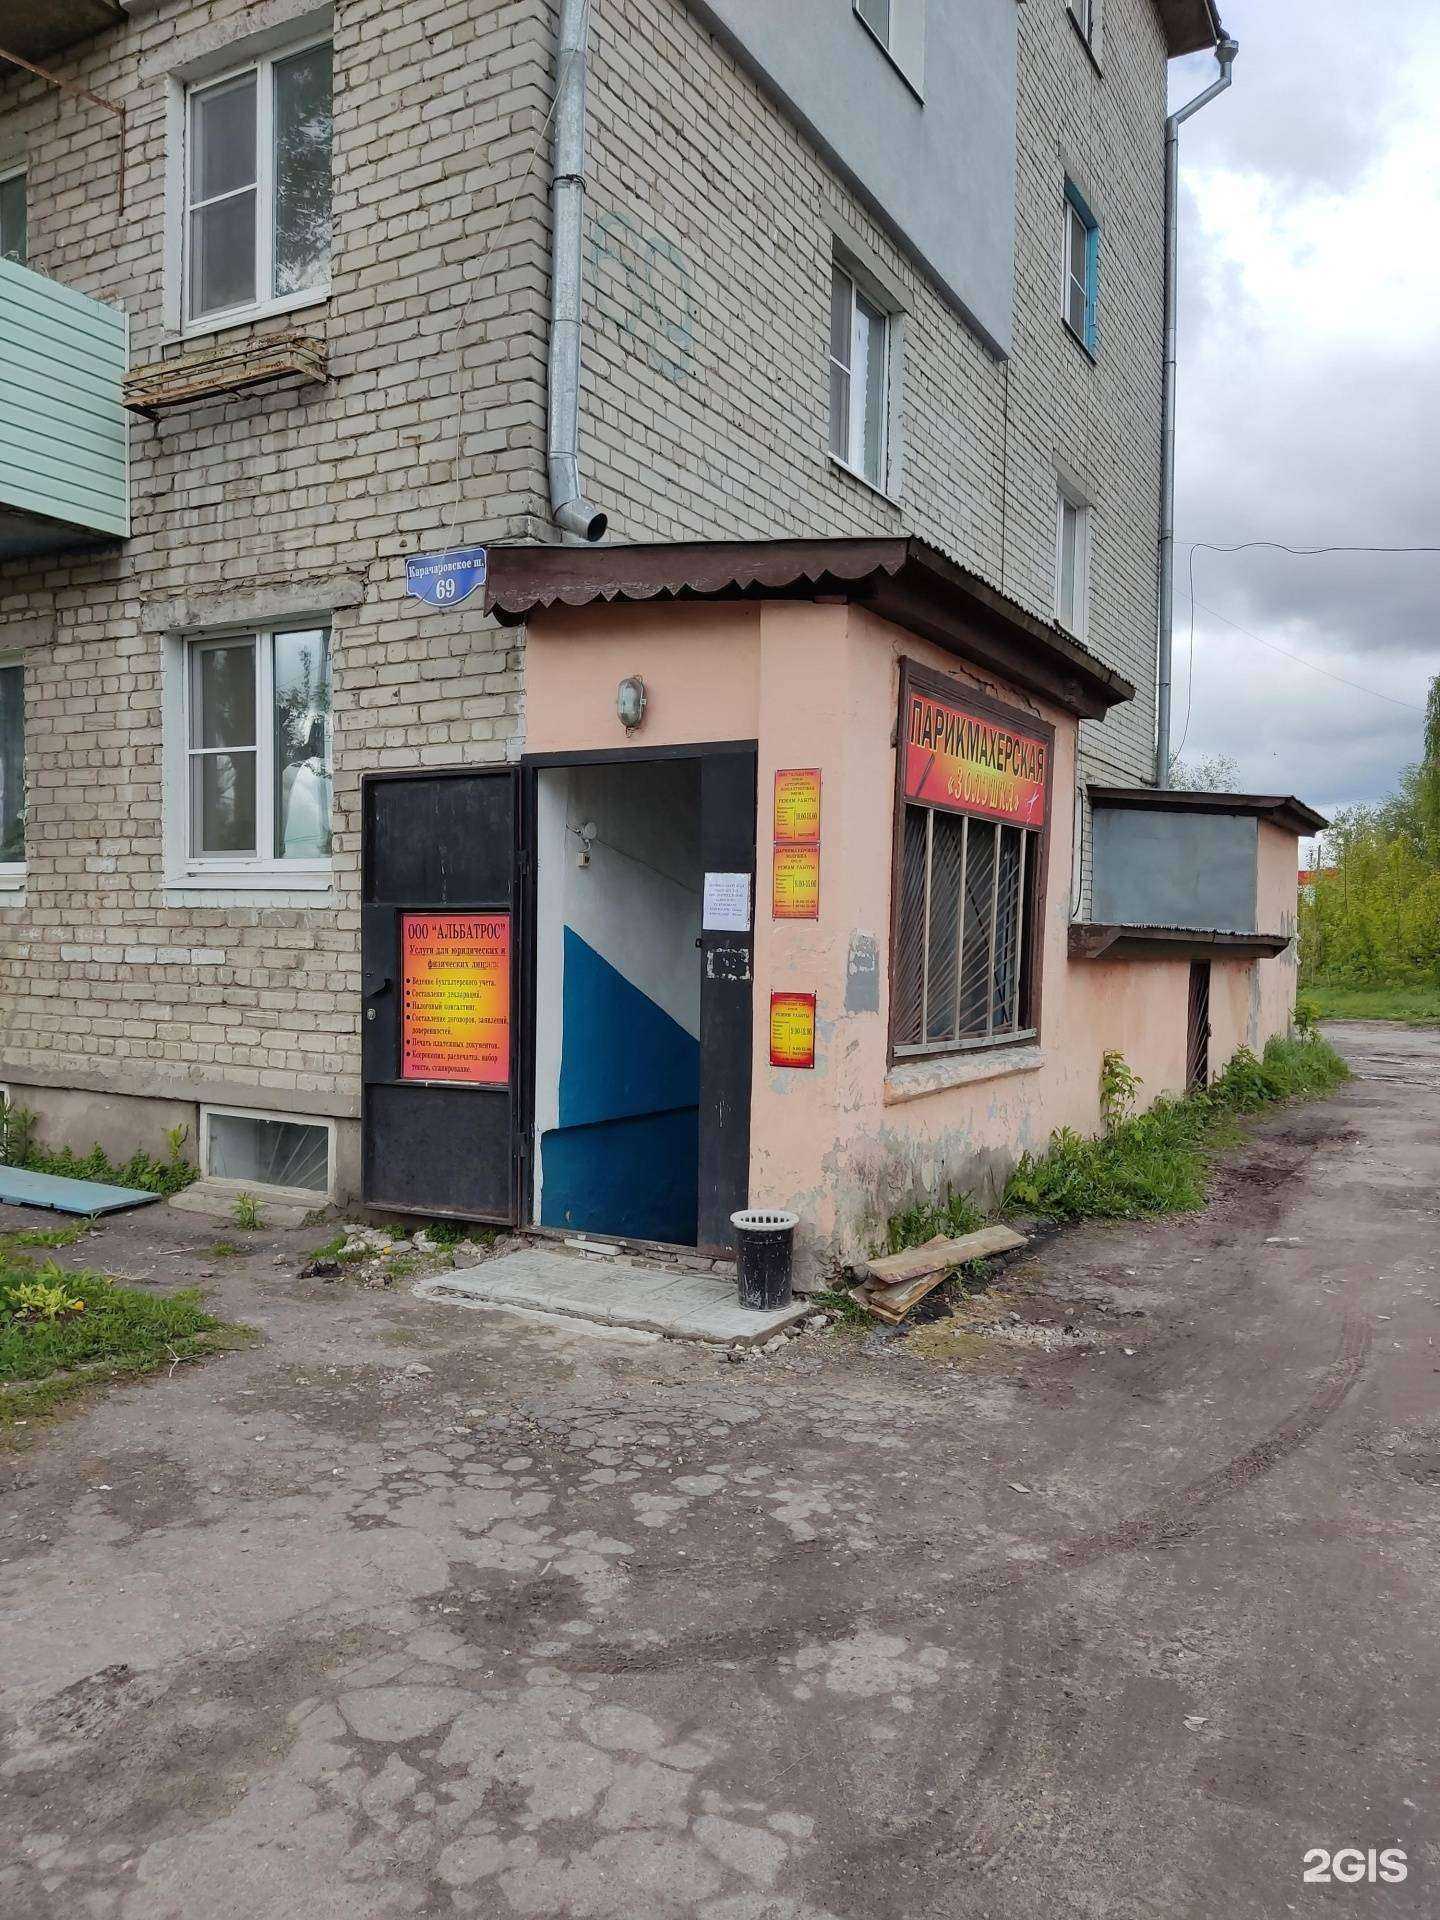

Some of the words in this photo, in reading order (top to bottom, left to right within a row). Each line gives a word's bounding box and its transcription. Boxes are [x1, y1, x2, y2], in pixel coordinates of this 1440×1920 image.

[408, 560, 472, 579] Карачаровское
[473, 558, 485, 567] ш.
[435, 578, 455, 599] 69
[910, 699, 1046, 786] ПАРИКМАХЕРСКАЯ
[407, 923, 430, 940] ООО
[432, 922, 506, 940] "АЛЬБАТРОС"
[409, 945, 434, 956] Услуги
[436, 947, 449, 955] для
[451, 947, 499, 957] юридических
[427, 959, 469, 969] физических
[412, 989, 446, 998] Составление
[412, 1013, 446, 1023] Составление
